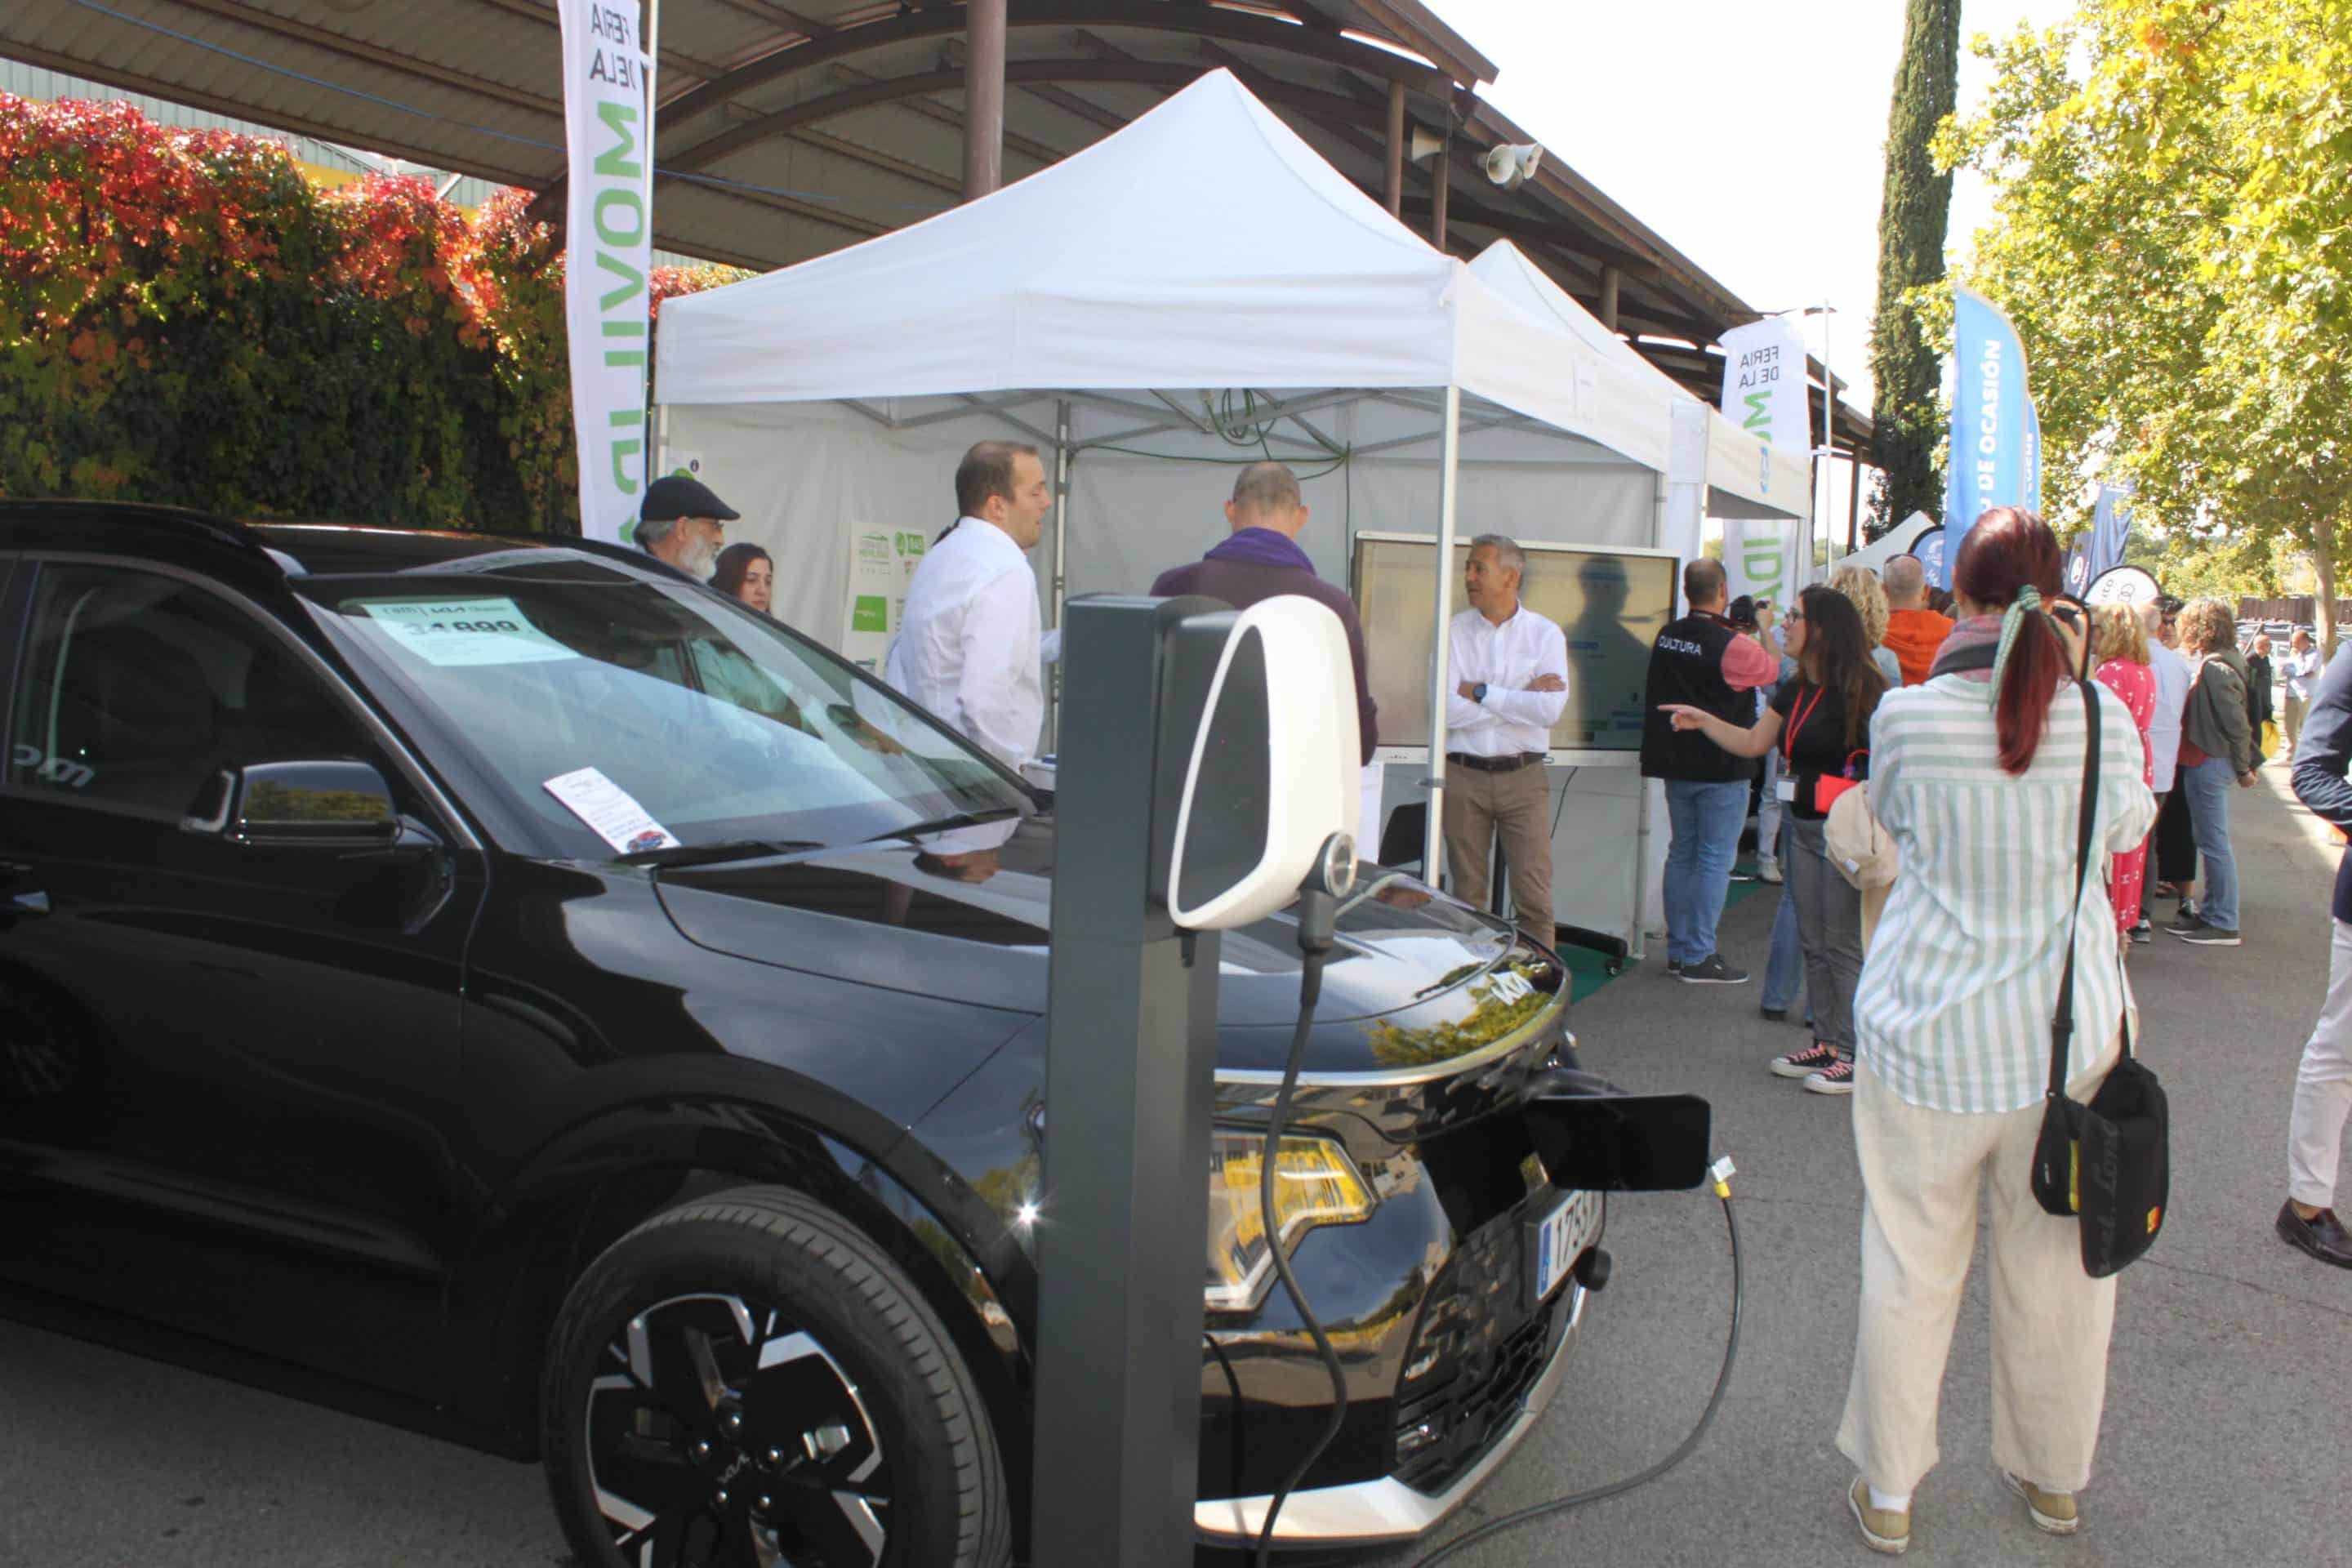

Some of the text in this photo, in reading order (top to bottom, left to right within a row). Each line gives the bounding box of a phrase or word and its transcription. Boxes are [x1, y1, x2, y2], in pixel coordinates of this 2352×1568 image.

[1979, 340, 2001, 455] OCASIÓN
[1977, 459, 1996, 492] DE
[1659, 635, 1702, 656] CULTURA
